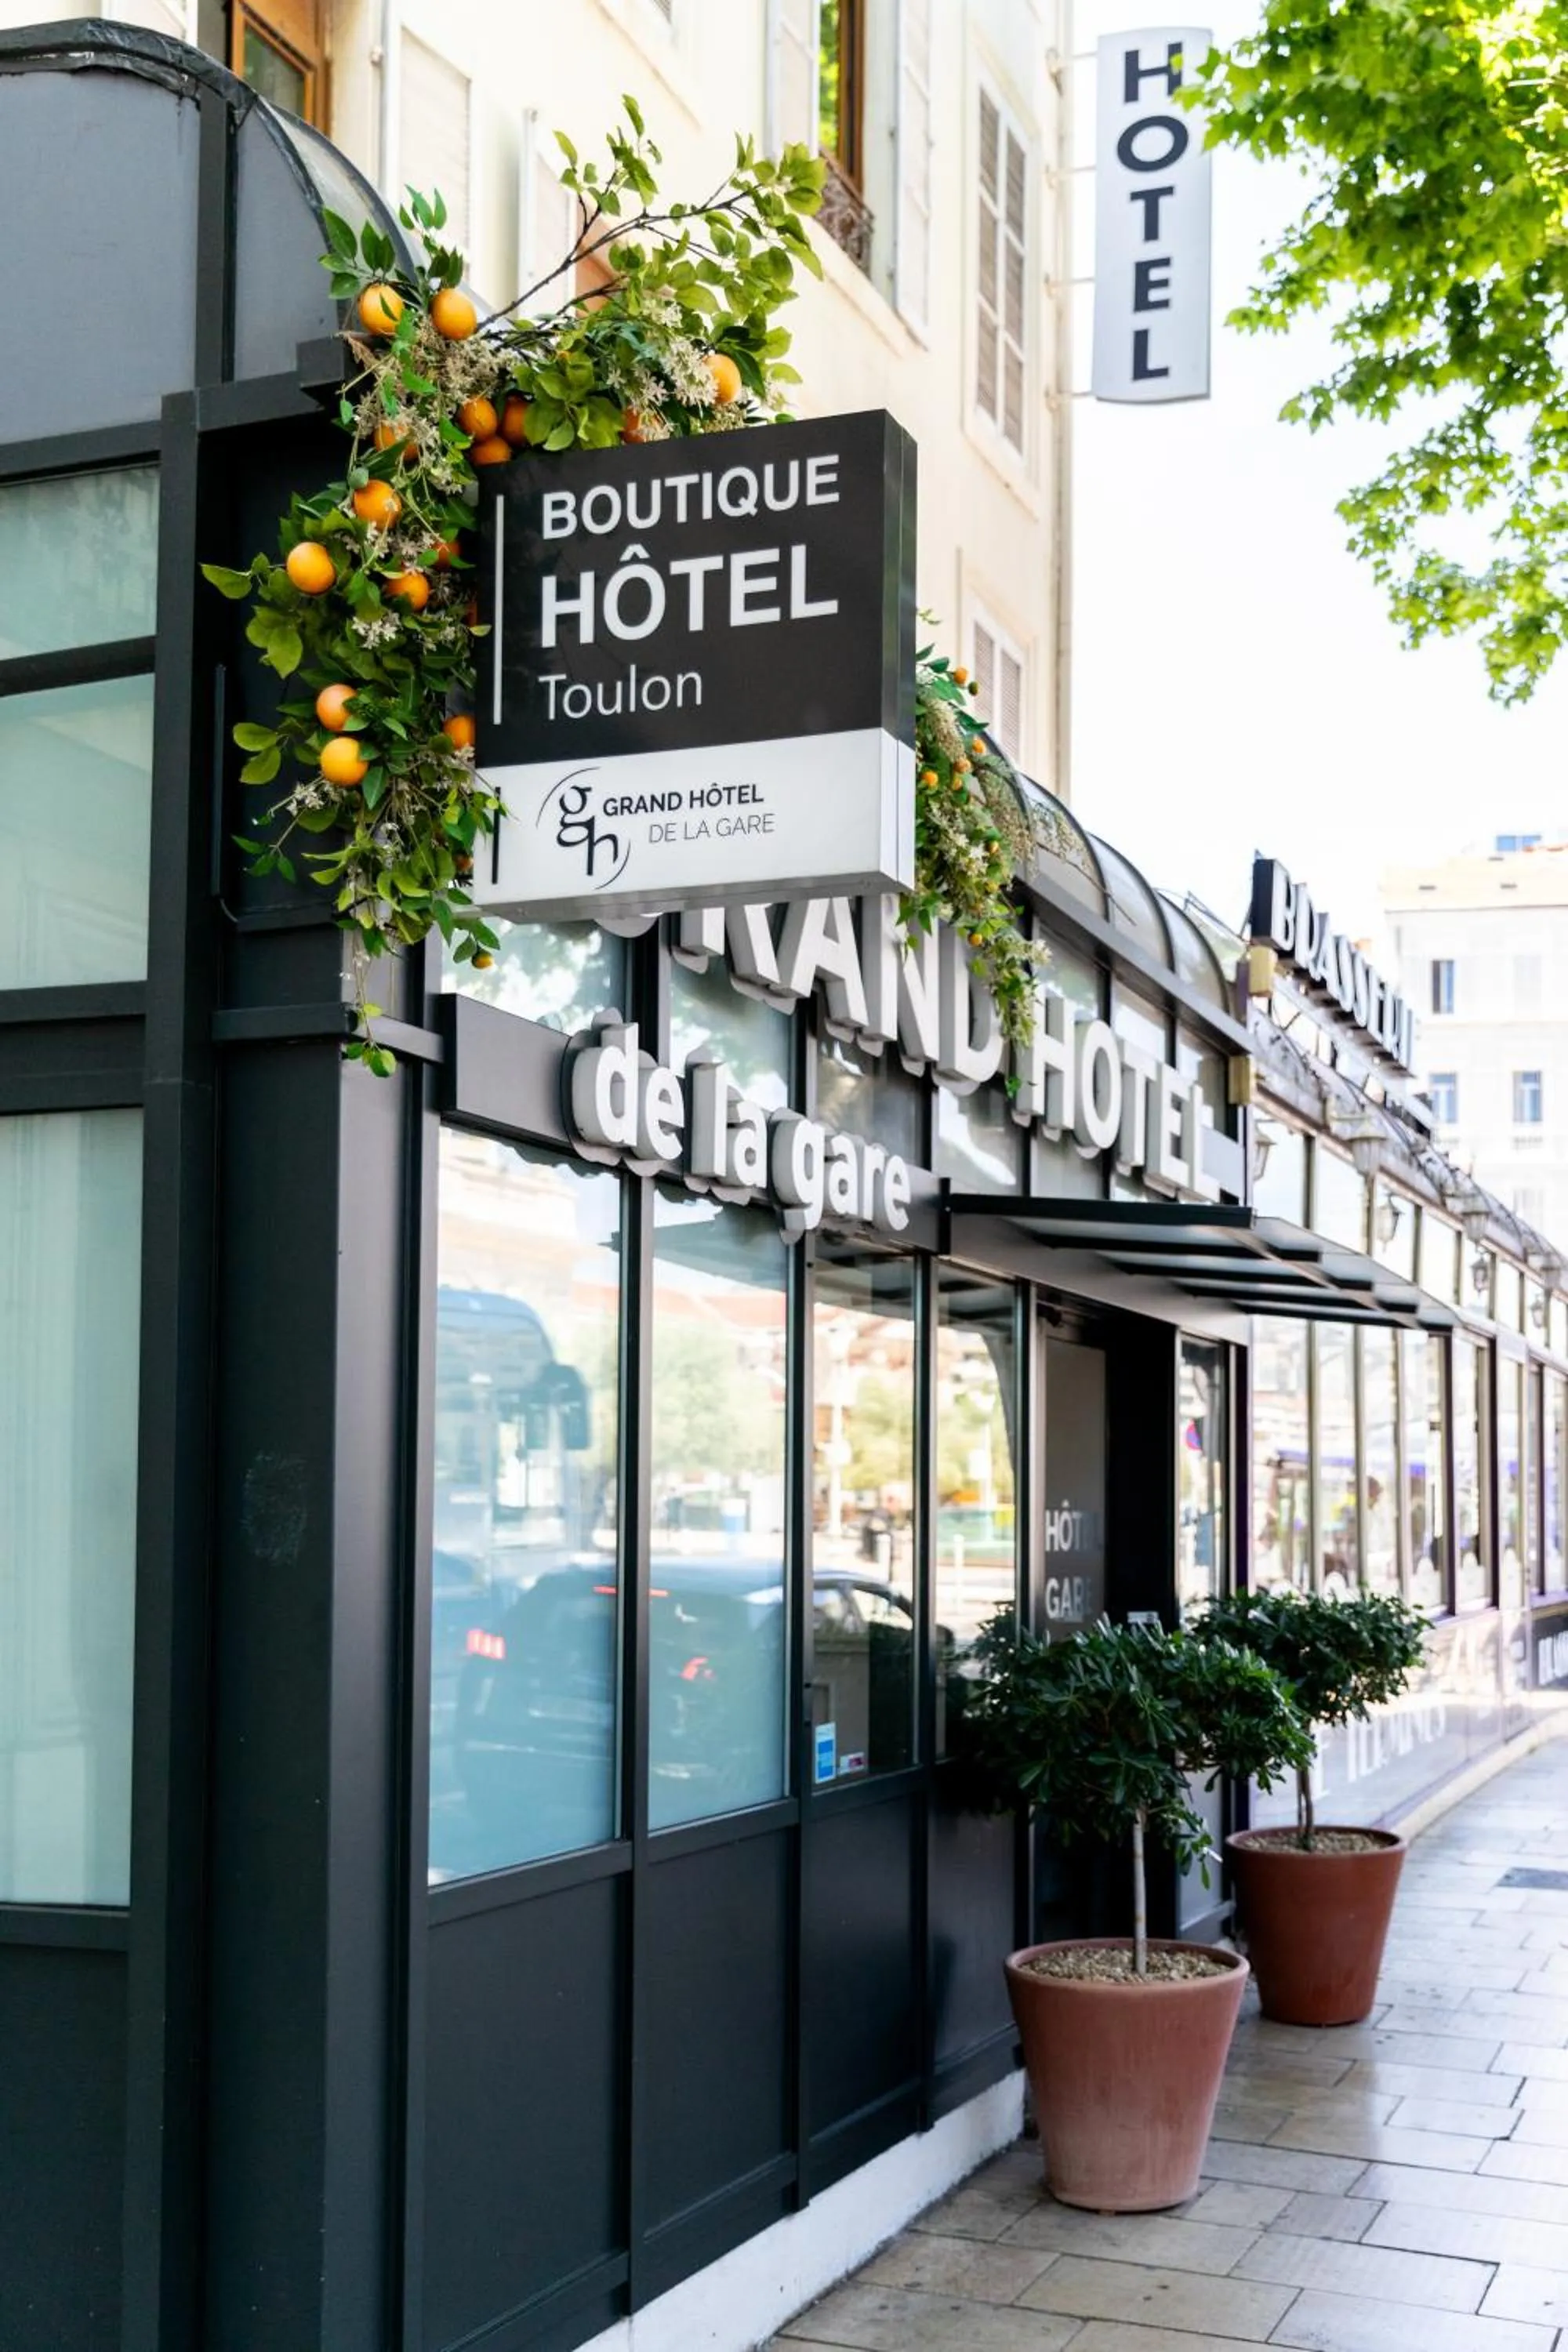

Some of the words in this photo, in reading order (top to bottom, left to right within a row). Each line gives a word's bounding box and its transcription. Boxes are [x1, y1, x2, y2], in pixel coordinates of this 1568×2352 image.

[1116, 42, 1189, 382] HOTEL
[542, 454, 840, 540] BOUTIQUE
[542, 543, 839, 648] HÔTEL
[539, 663, 702, 720] Toulon
[603, 791, 683, 817] GRAND
[689, 782, 764, 809] HÔTEL
[648, 822, 677, 844] DE
[684, 820, 712, 840] LA
[716, 813, 775, 837] GARE
[574, 1022, 684, 1160] de
[693, 1062, 767, 1189] la
[771, 1117, 912, 1230] gare
[1019, 986, 1221, 1203] HOTEL
